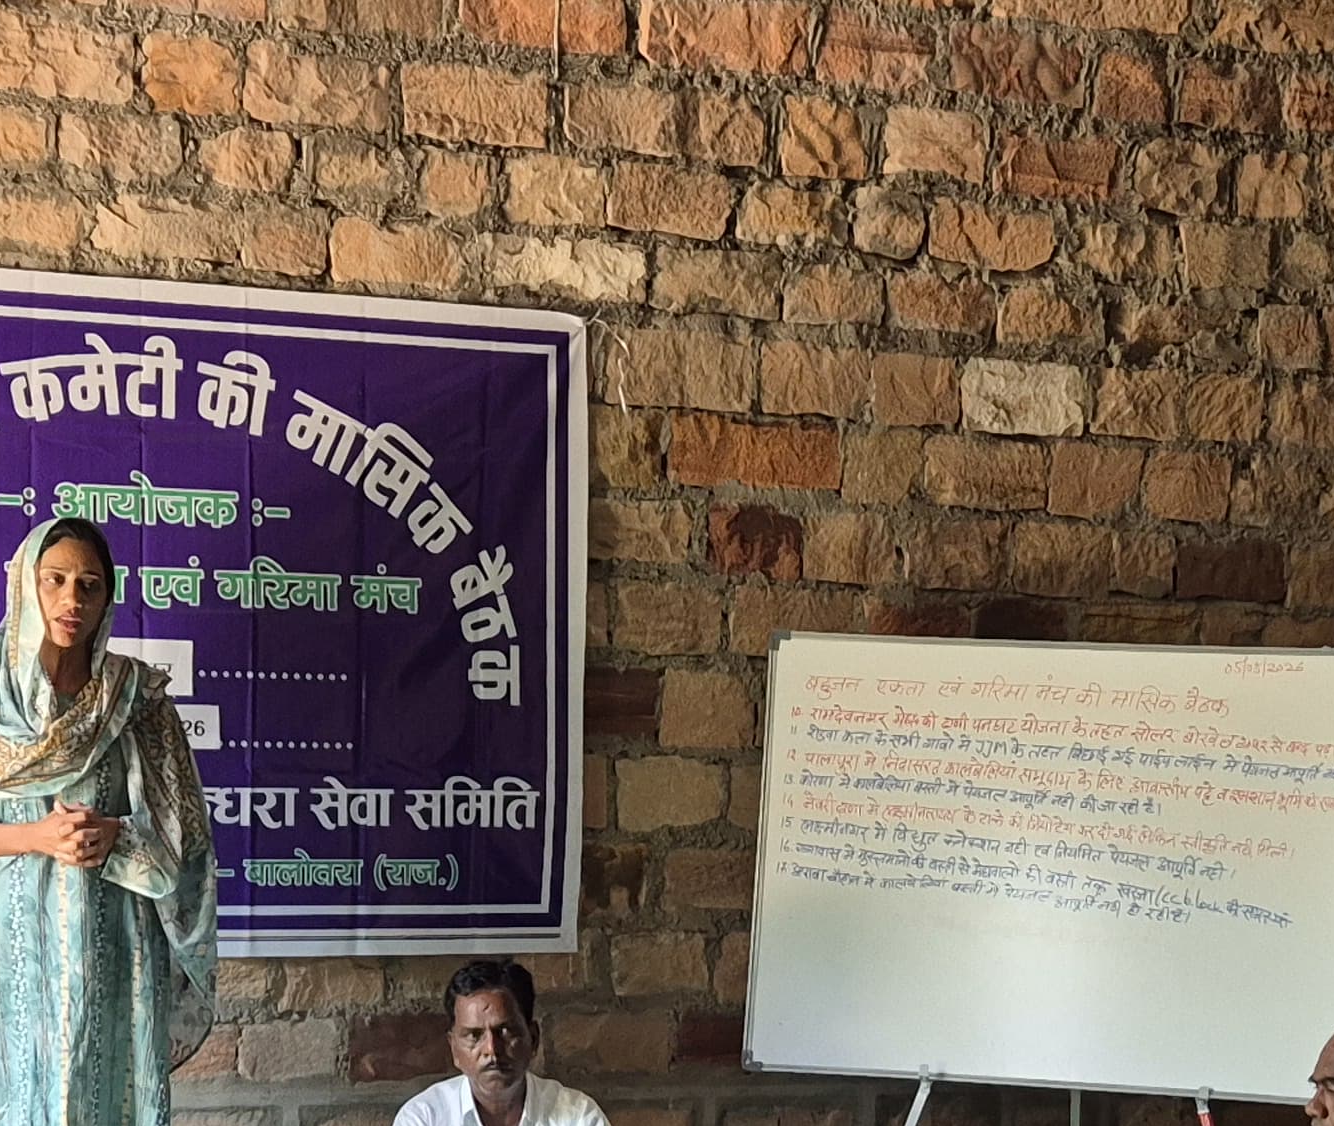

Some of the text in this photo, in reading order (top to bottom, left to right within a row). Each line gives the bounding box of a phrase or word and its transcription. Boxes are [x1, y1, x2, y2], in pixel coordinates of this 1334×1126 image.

[0, 332, 184, 422] कमेटी
[196, 350, 277, 437] की
[285, 389, 474, 554] मासिक
[450, 545, 521, 706] बैठक
[51, 470, 239, 528] आयोजक
[139, 555, 204, 609] एवं
[214, 555, 342, 611] गरिमा
[350, 563, 423, 614] मंच
[1076, 682, 1107, 708] की
[310, 776, 395, 830] सेवा
[404, 775, 541, 830] समिति
[243, 848, 460, 892] बालोतरा (राज.)
